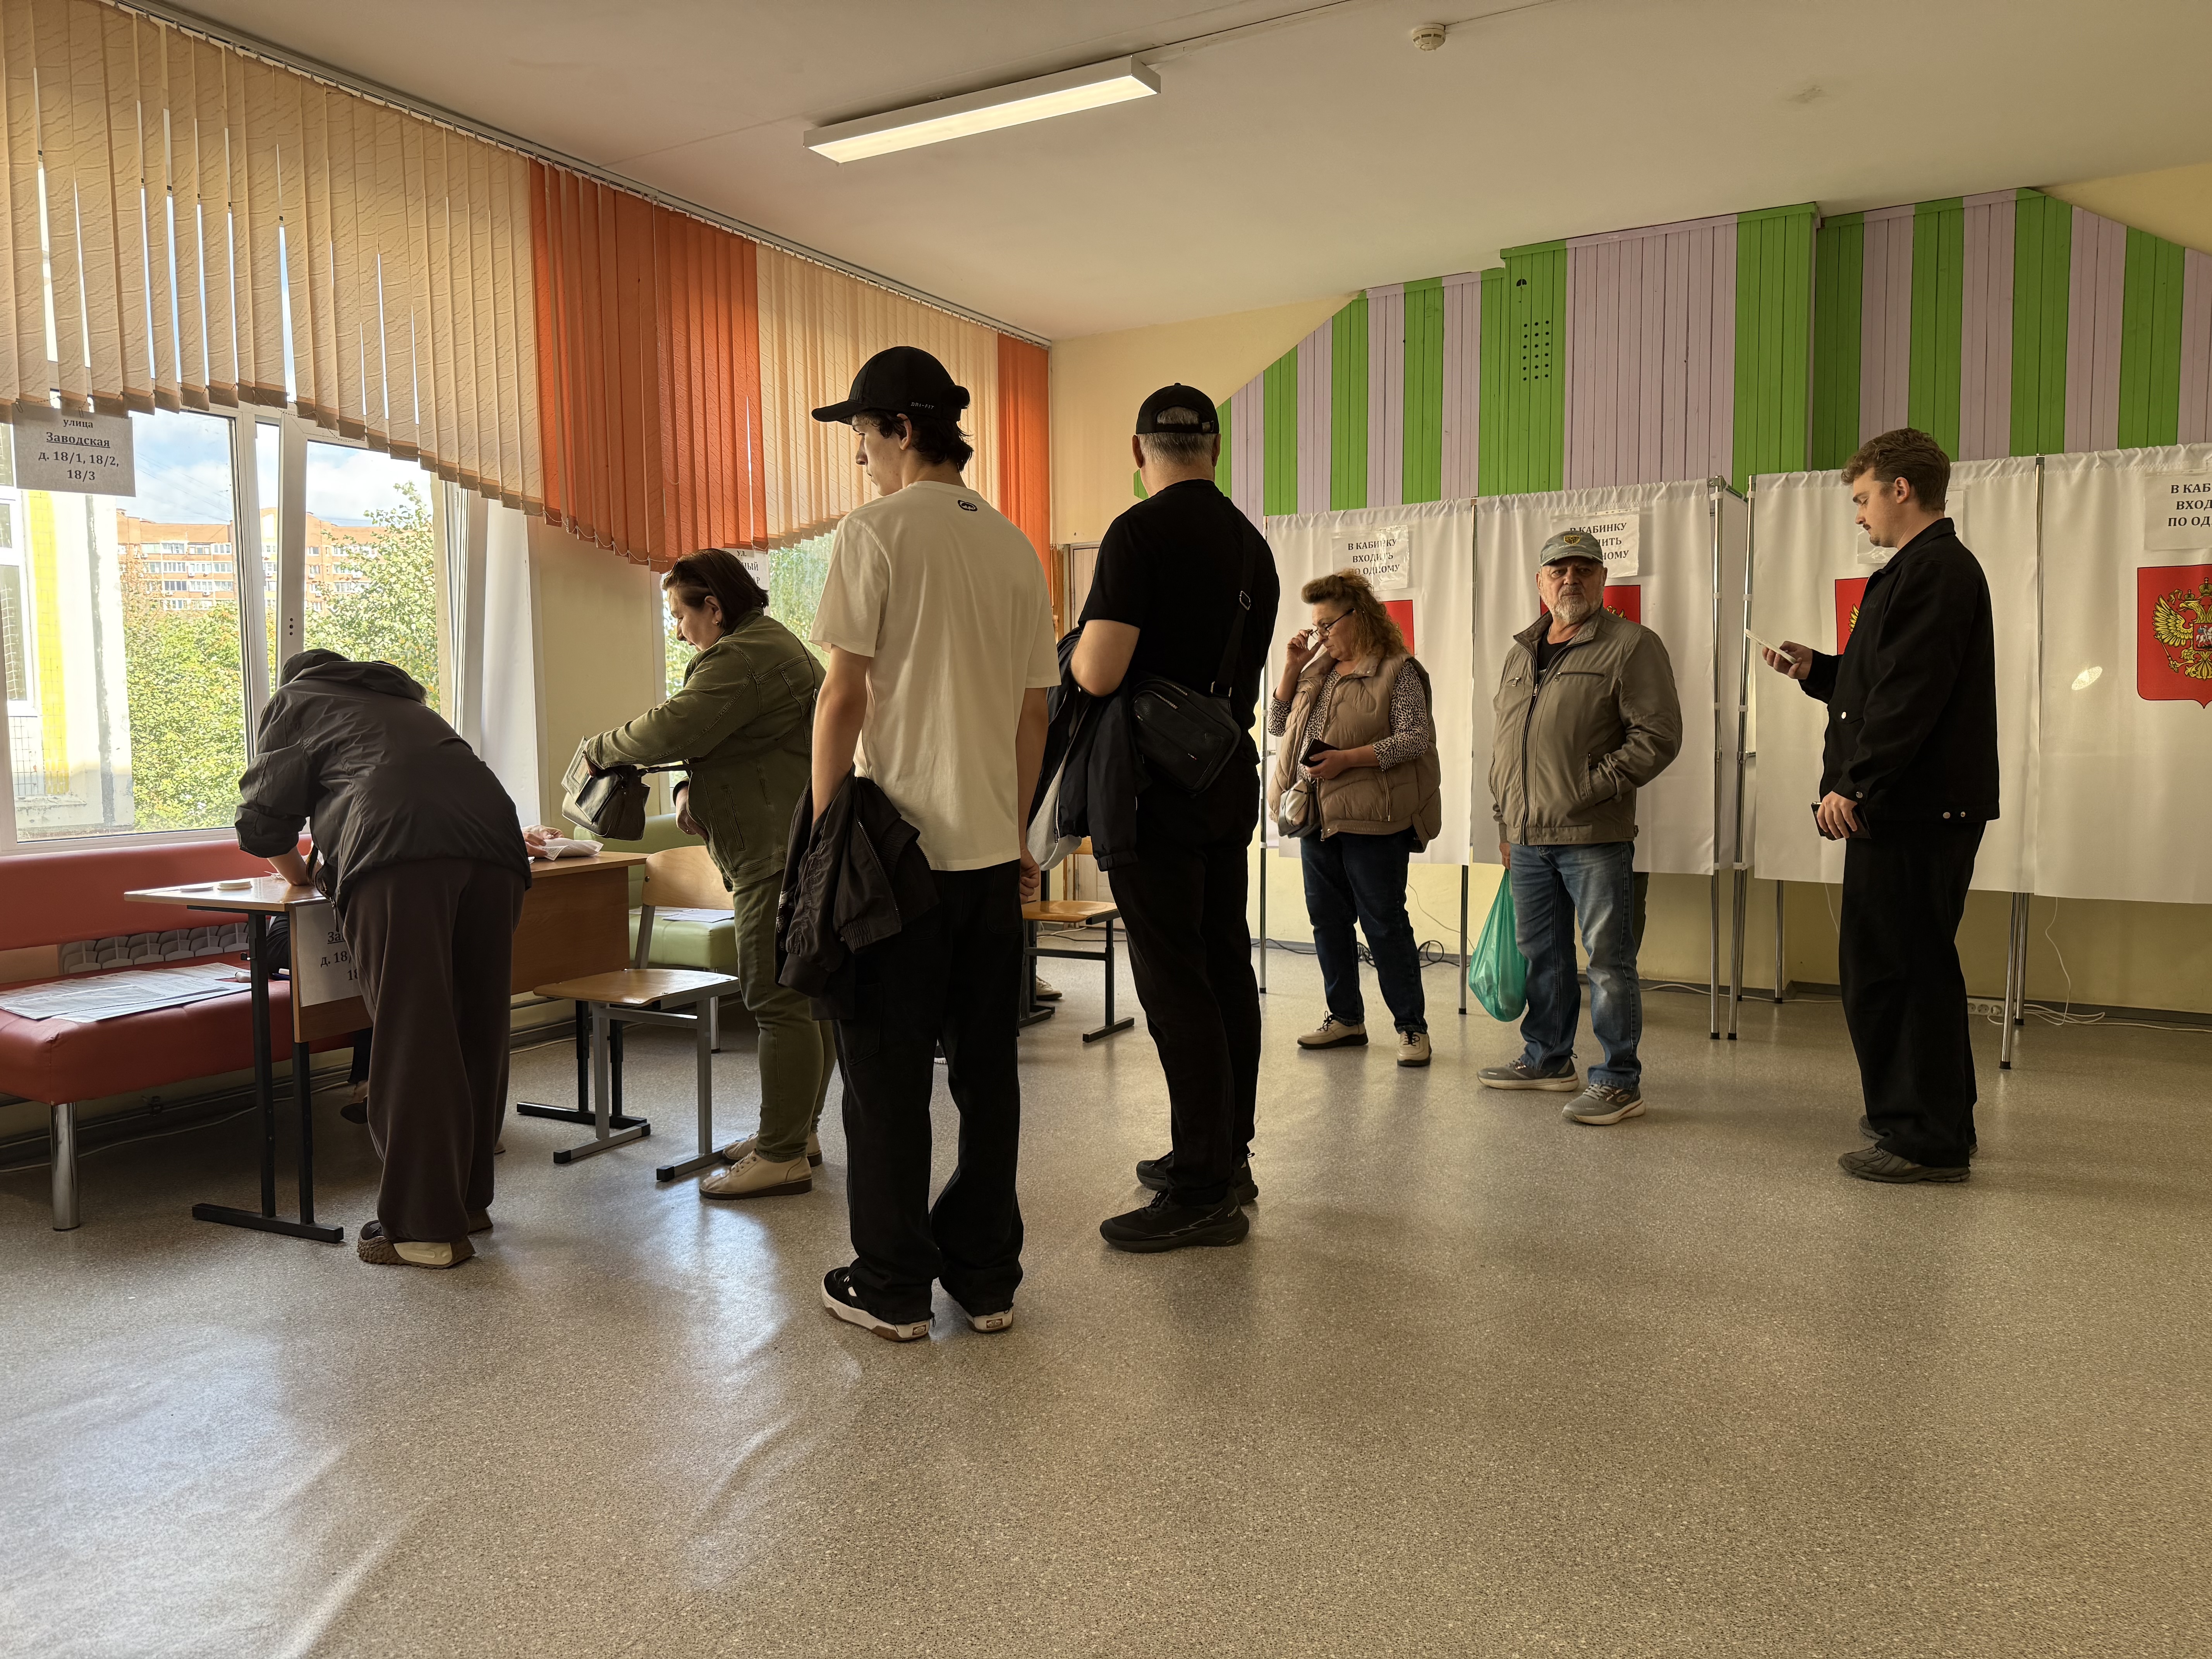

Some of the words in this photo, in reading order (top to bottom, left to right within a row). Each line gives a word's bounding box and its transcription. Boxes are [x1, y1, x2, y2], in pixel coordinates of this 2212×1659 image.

[63, 419, 93, 429] улица
[46, 432, 110, 448] Заводская
[38, 452, 49, 461] д.
[53, 451, 86, 464] 18/1,
[89, 455, 119, 467] 18/2,
[67, 469, 95, 482] 18/3
[2171, 485, 2179, 494] В
[2183, 483, 2212, 493] КАБ
[2168, 517, 2187, 527] ПО
[321, 957, 330, 968] д.
